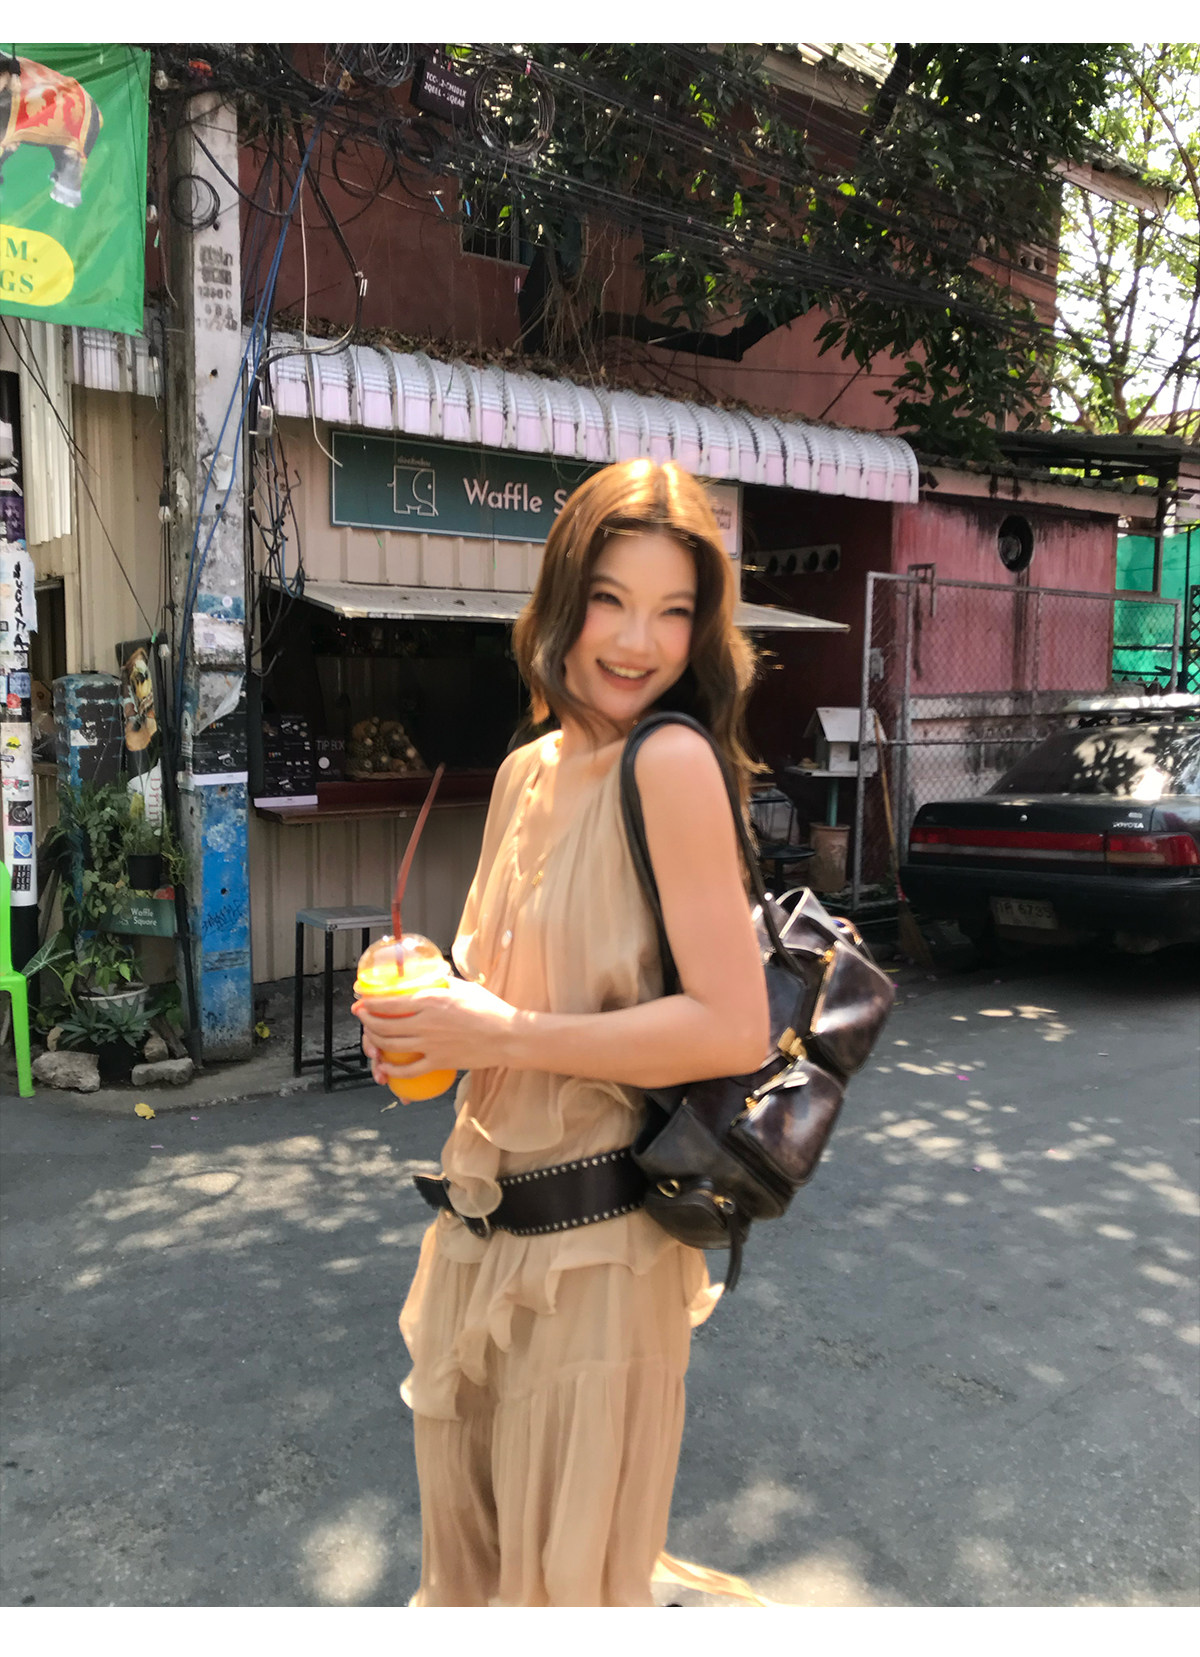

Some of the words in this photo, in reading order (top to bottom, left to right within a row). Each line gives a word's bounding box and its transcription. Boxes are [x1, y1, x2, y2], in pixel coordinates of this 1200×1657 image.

[0, 270, 34, 294] GS
[463, 477, 543, 513] Waffle
[130, 907, 154, 918] Waffle
[133, 916, 157, 926] Square
